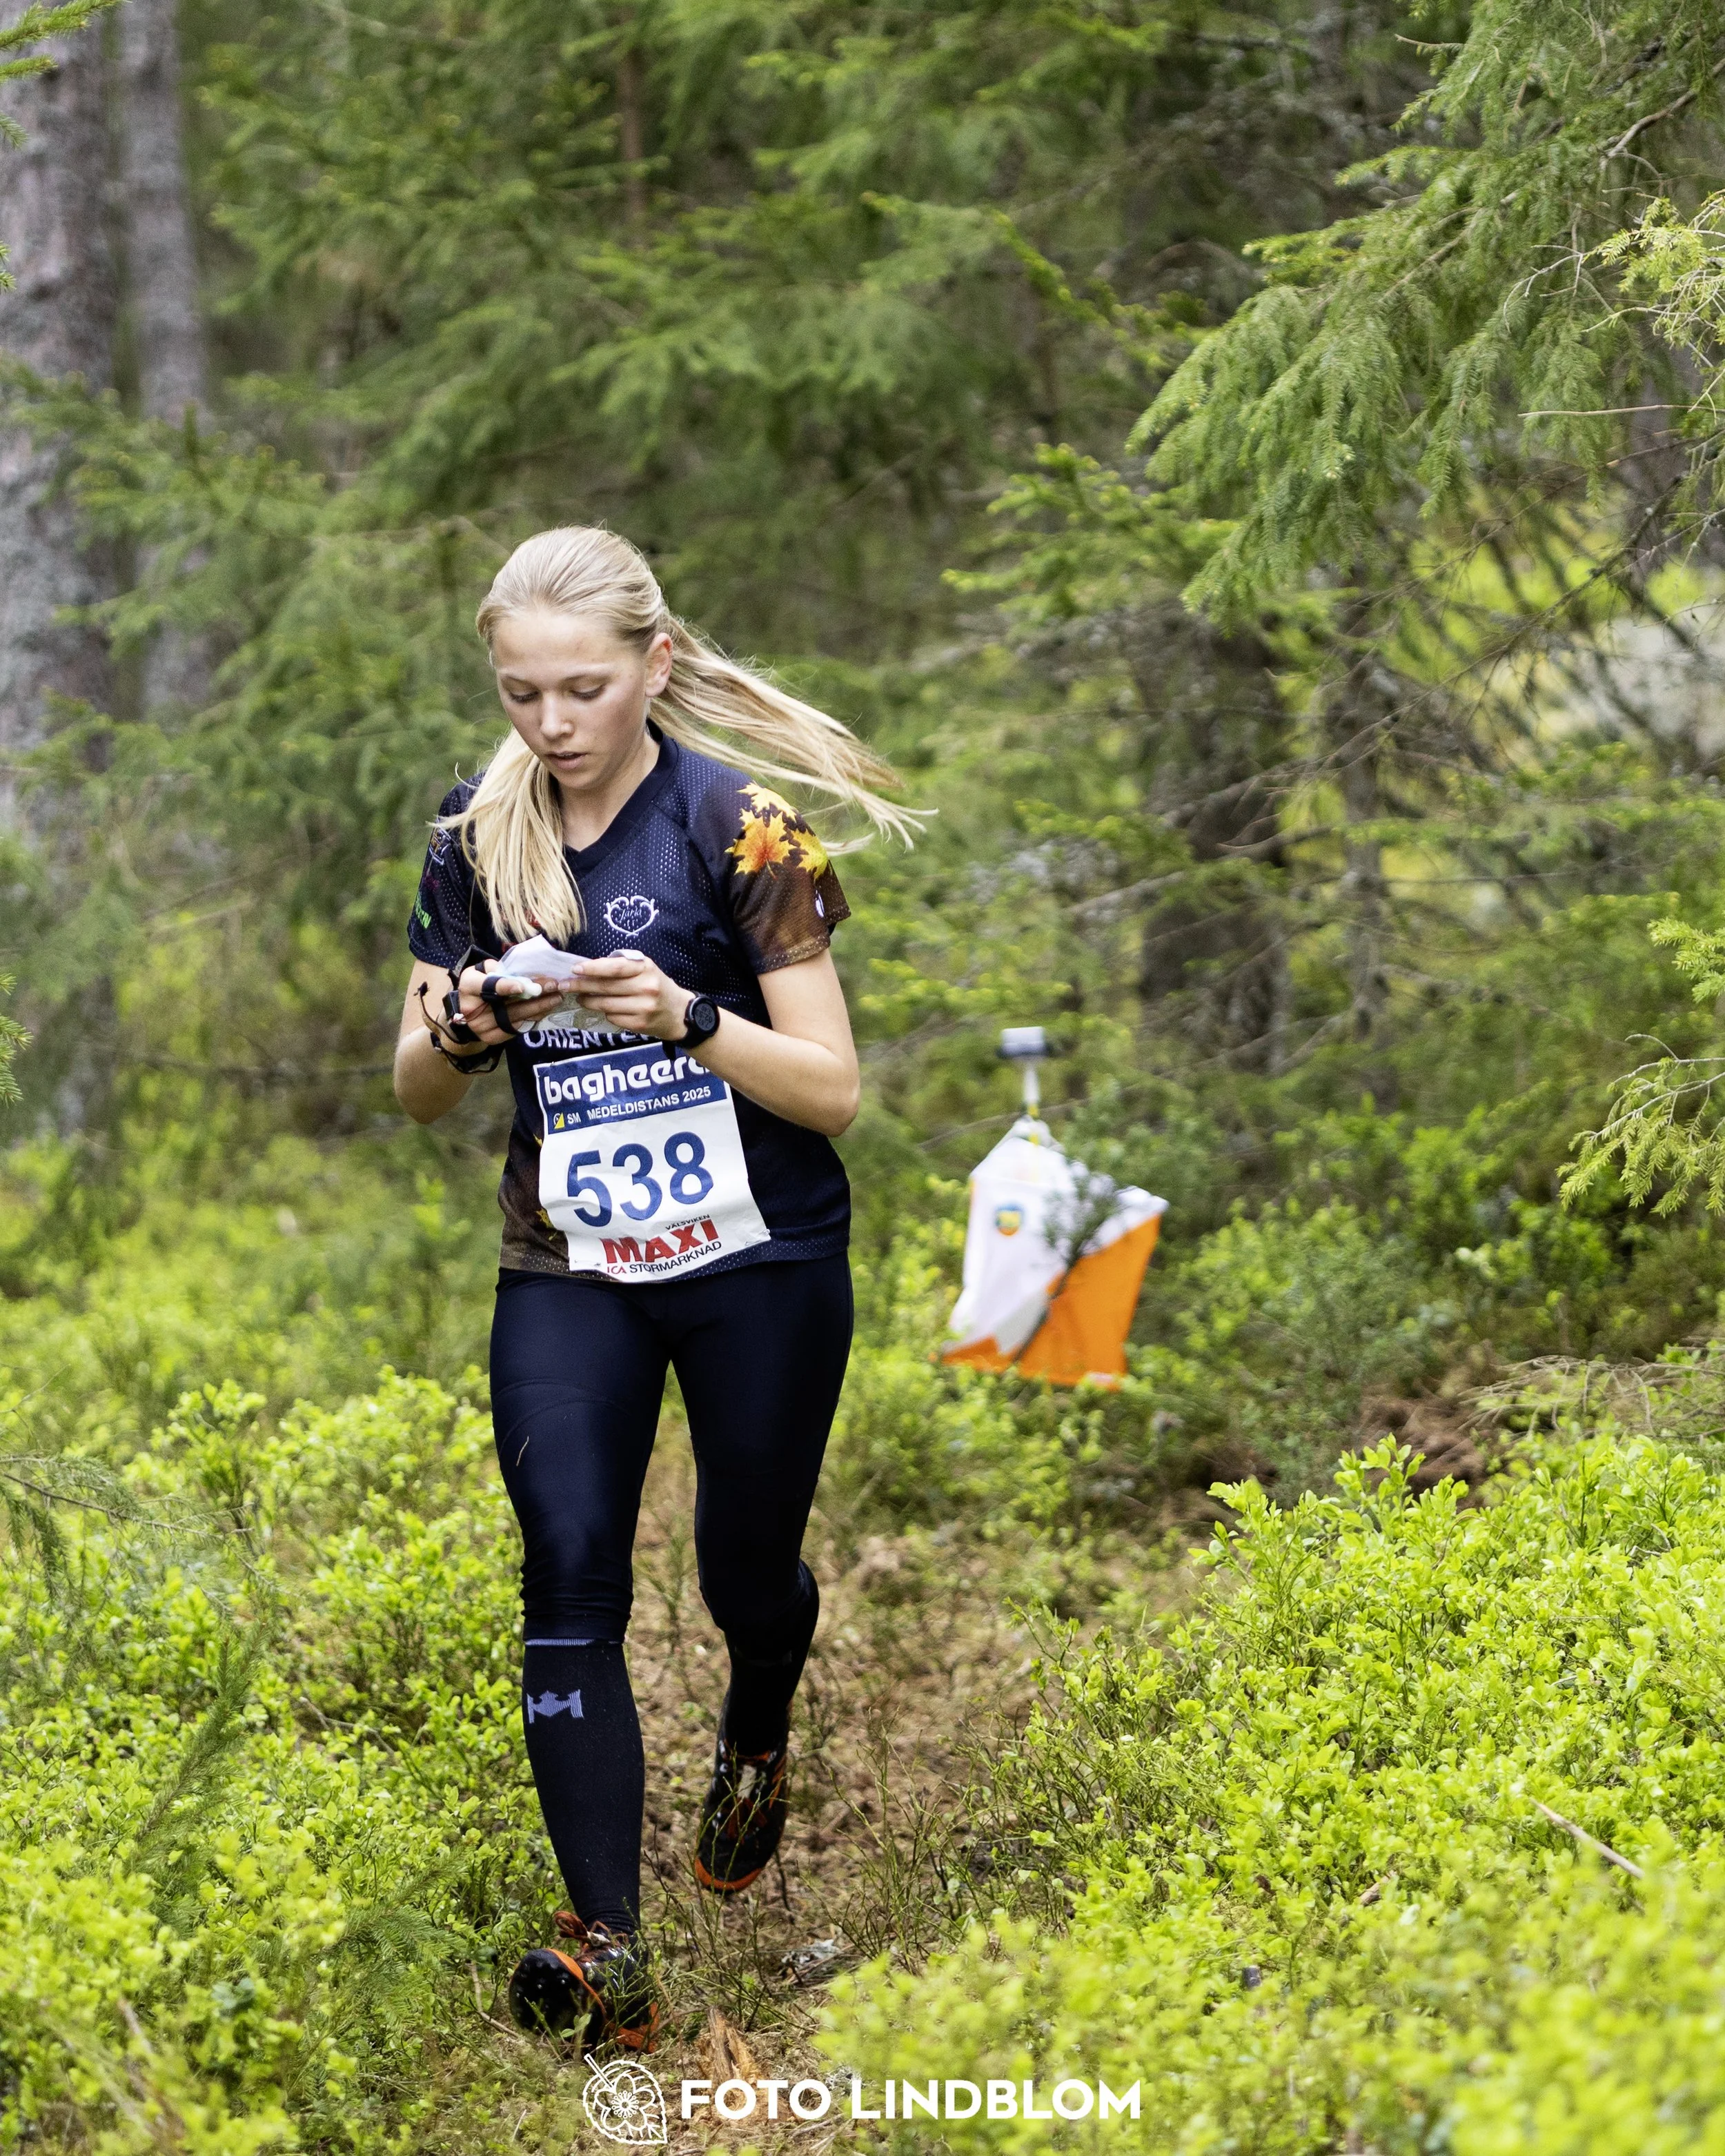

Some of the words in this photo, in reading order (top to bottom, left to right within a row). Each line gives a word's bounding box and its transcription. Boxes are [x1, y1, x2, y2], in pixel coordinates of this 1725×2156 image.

[567, 1111, 582, 1125] SM
[586, 1094, 680, 1120] MEDELDISTANS
[682, 1086, 711, 1102] 2025
[566, 1131, 713, 1227] 538
[599, 1219, 719, 1263] MAXI
[665, 1214, 711, 1230] VÄLSVIKEN
[607, 1265, 627, 1274] ICA
[629, 1240, 722, 1274] STORMARKNAD
